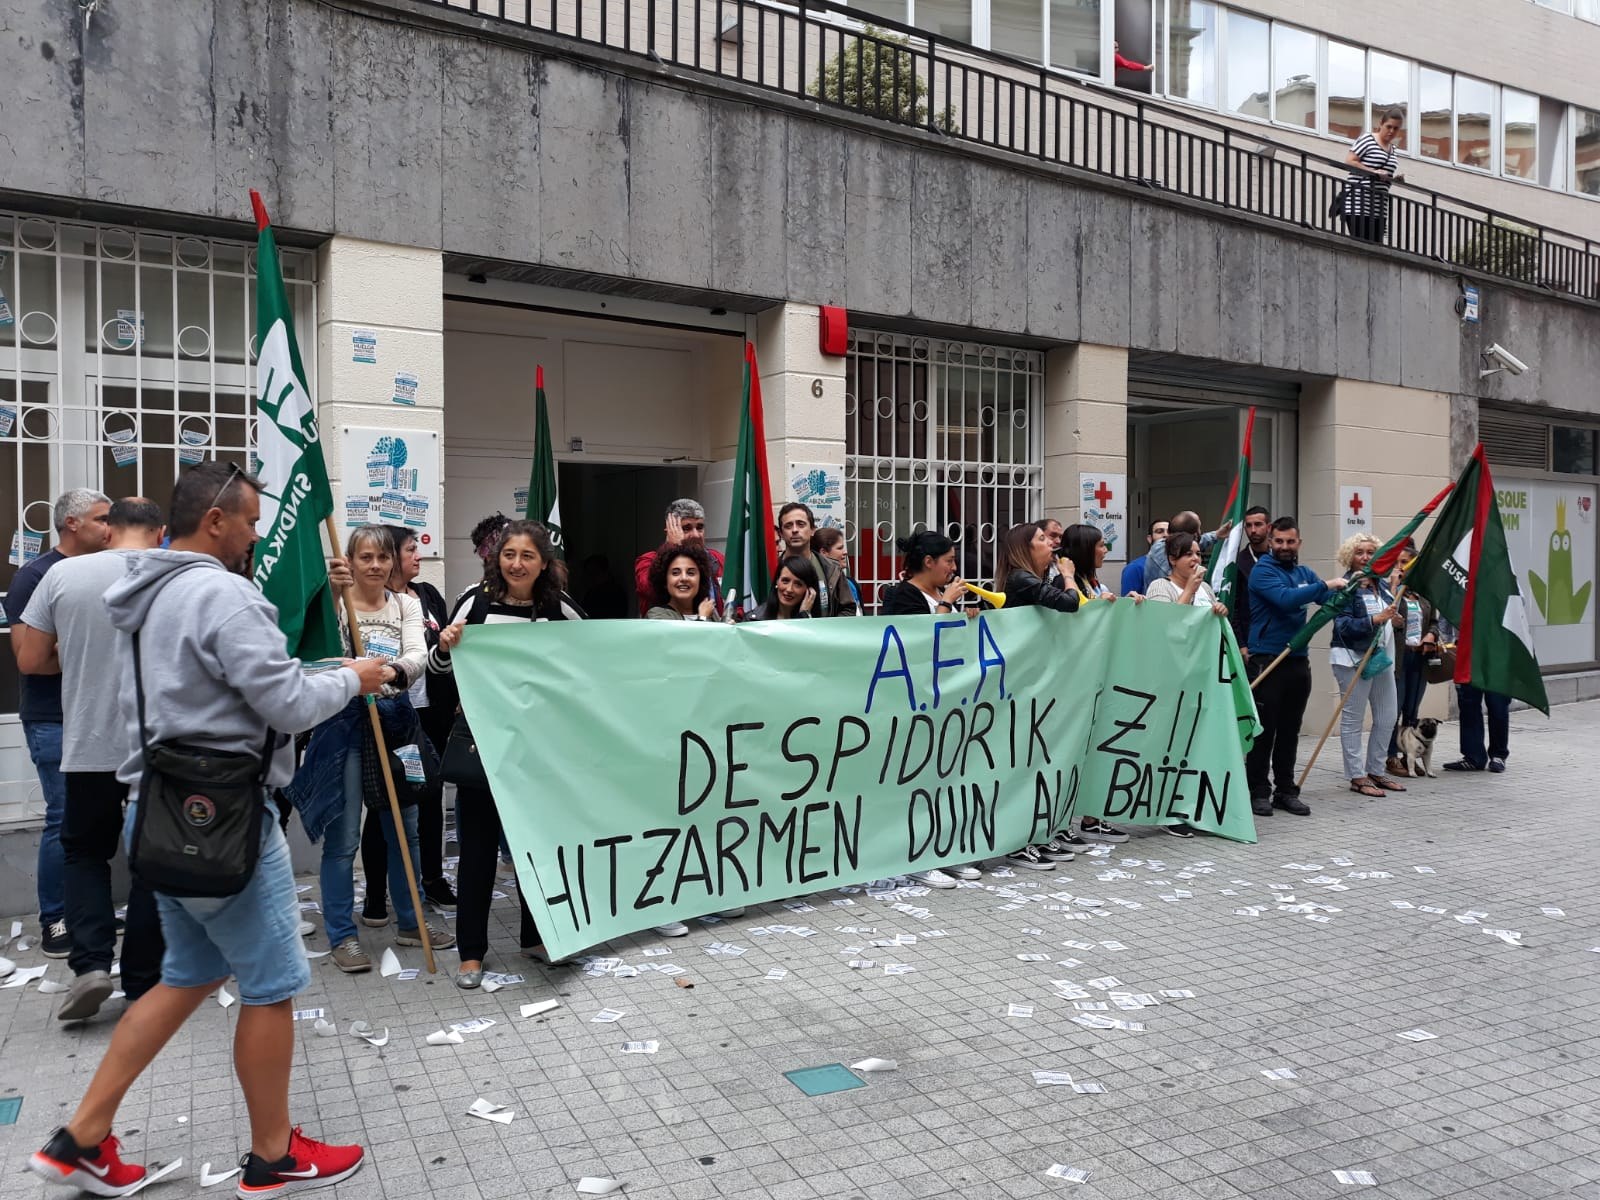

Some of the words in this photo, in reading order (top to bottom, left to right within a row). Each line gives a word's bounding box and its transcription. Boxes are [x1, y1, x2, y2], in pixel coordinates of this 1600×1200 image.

[811, 378, 823, 398] 6
[1497, 490, 1527, 509] SQUE
[1441, 559, 1470, 590] EUSK
[865, 615, 1013, 713] A.F.A.
[678, 698, 1056, 815] DESPIDORIK
[527, 794, 863, 942] HITZARMEN
[908, 779, 999, 862] DUIN
[1103, 757, 1231, 826] BATEN
